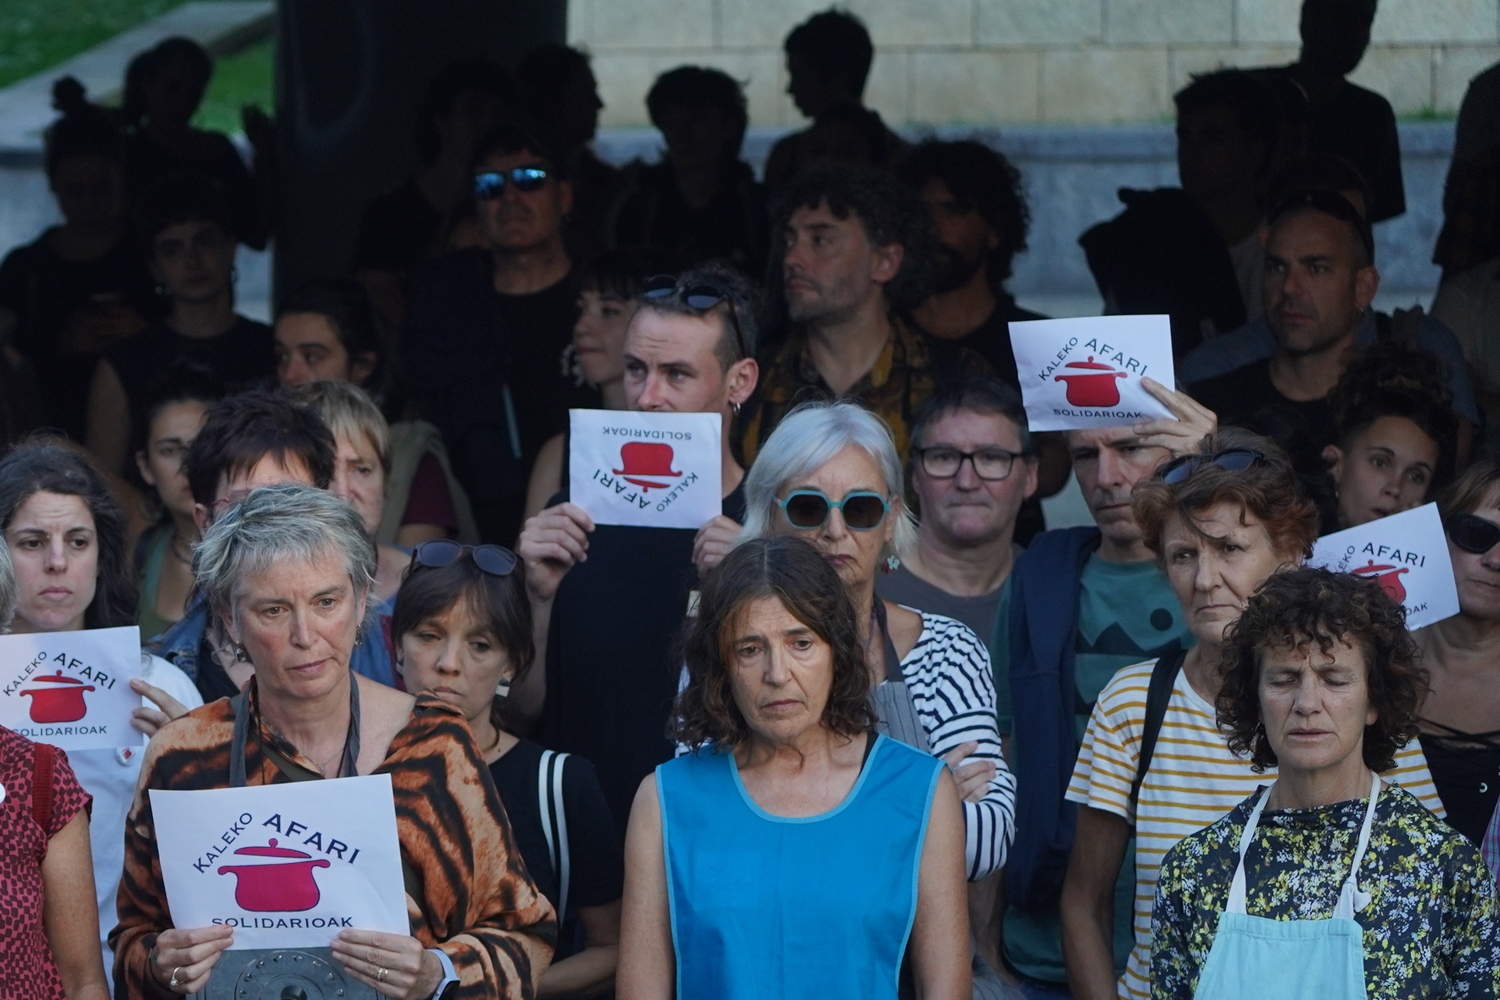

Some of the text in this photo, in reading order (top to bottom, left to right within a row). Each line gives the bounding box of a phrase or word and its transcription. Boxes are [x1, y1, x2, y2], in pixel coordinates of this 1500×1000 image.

[1038, 337, 1149, 381] KALEKO AFARI
[1053, 408, 1144, 419] SOLIDARIOAK
[602, 426, 693, 441] SOLIDARIOAK
[592, 469, 699, 512] KALEKO AFARI
[1362, 542, 1426, 568] AFARI
[3, 651, 117, 697] KALEKO AFARI
[192, 812, 361, 874] KALEKO AFARI
[211, 916, 354, 929] SOLIDARIOAK
